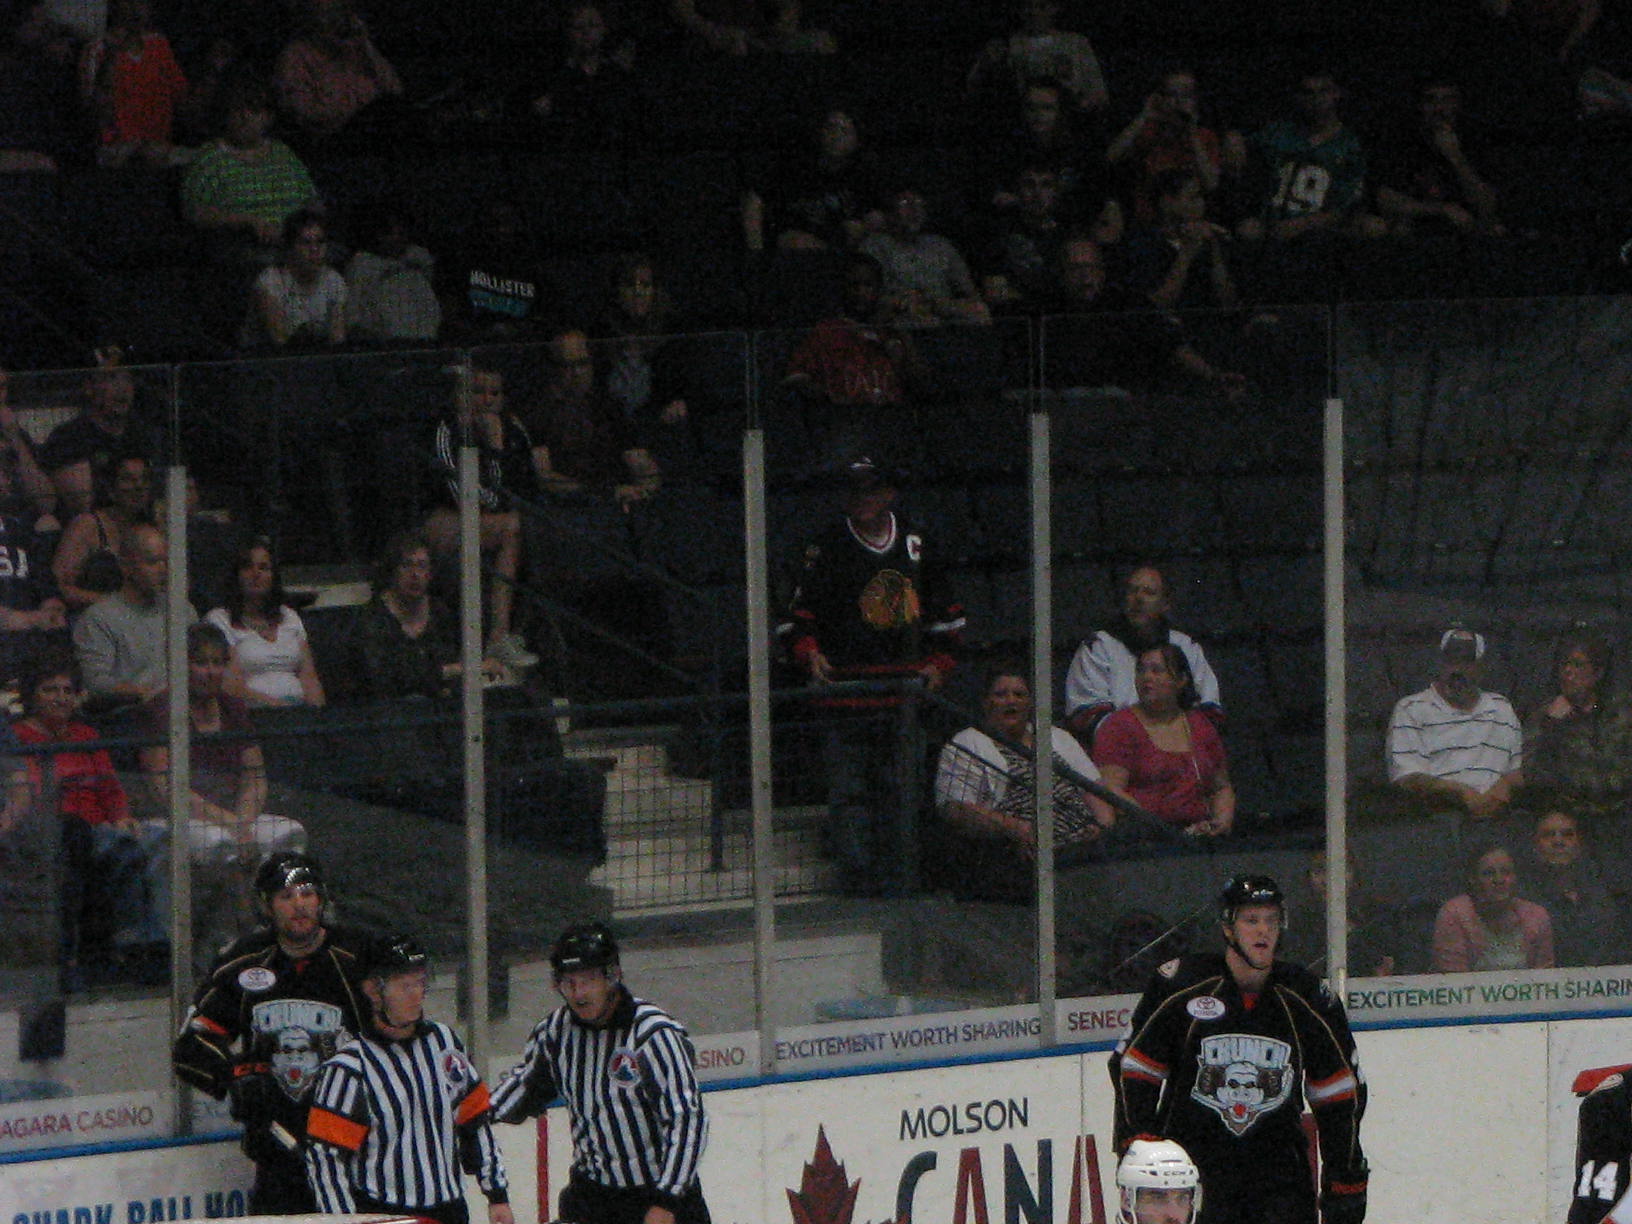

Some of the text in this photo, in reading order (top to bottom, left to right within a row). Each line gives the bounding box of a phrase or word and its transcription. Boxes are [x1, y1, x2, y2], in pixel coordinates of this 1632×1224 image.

[469, 269, 535, 298] HOLLISTER
[1347, 987, 1476, 1011] EXCITEMENT
[1481, 982, 1560, 1004] WORTH
[1068, 1008, 1131, 1033] SENEC
[775, 1019, 1042, 1060] EXCITEMENT WORTH SHARING
[1201, 1035, 1291, 1069] CRUNCH
[695, 1046, 745, 1071] SINO
[0, 1106, 153, 1139] AGARA CASINO
[900, 1096, 1029, 1140] MOLSON
[1576, 1160, 1618, 1201] 14
